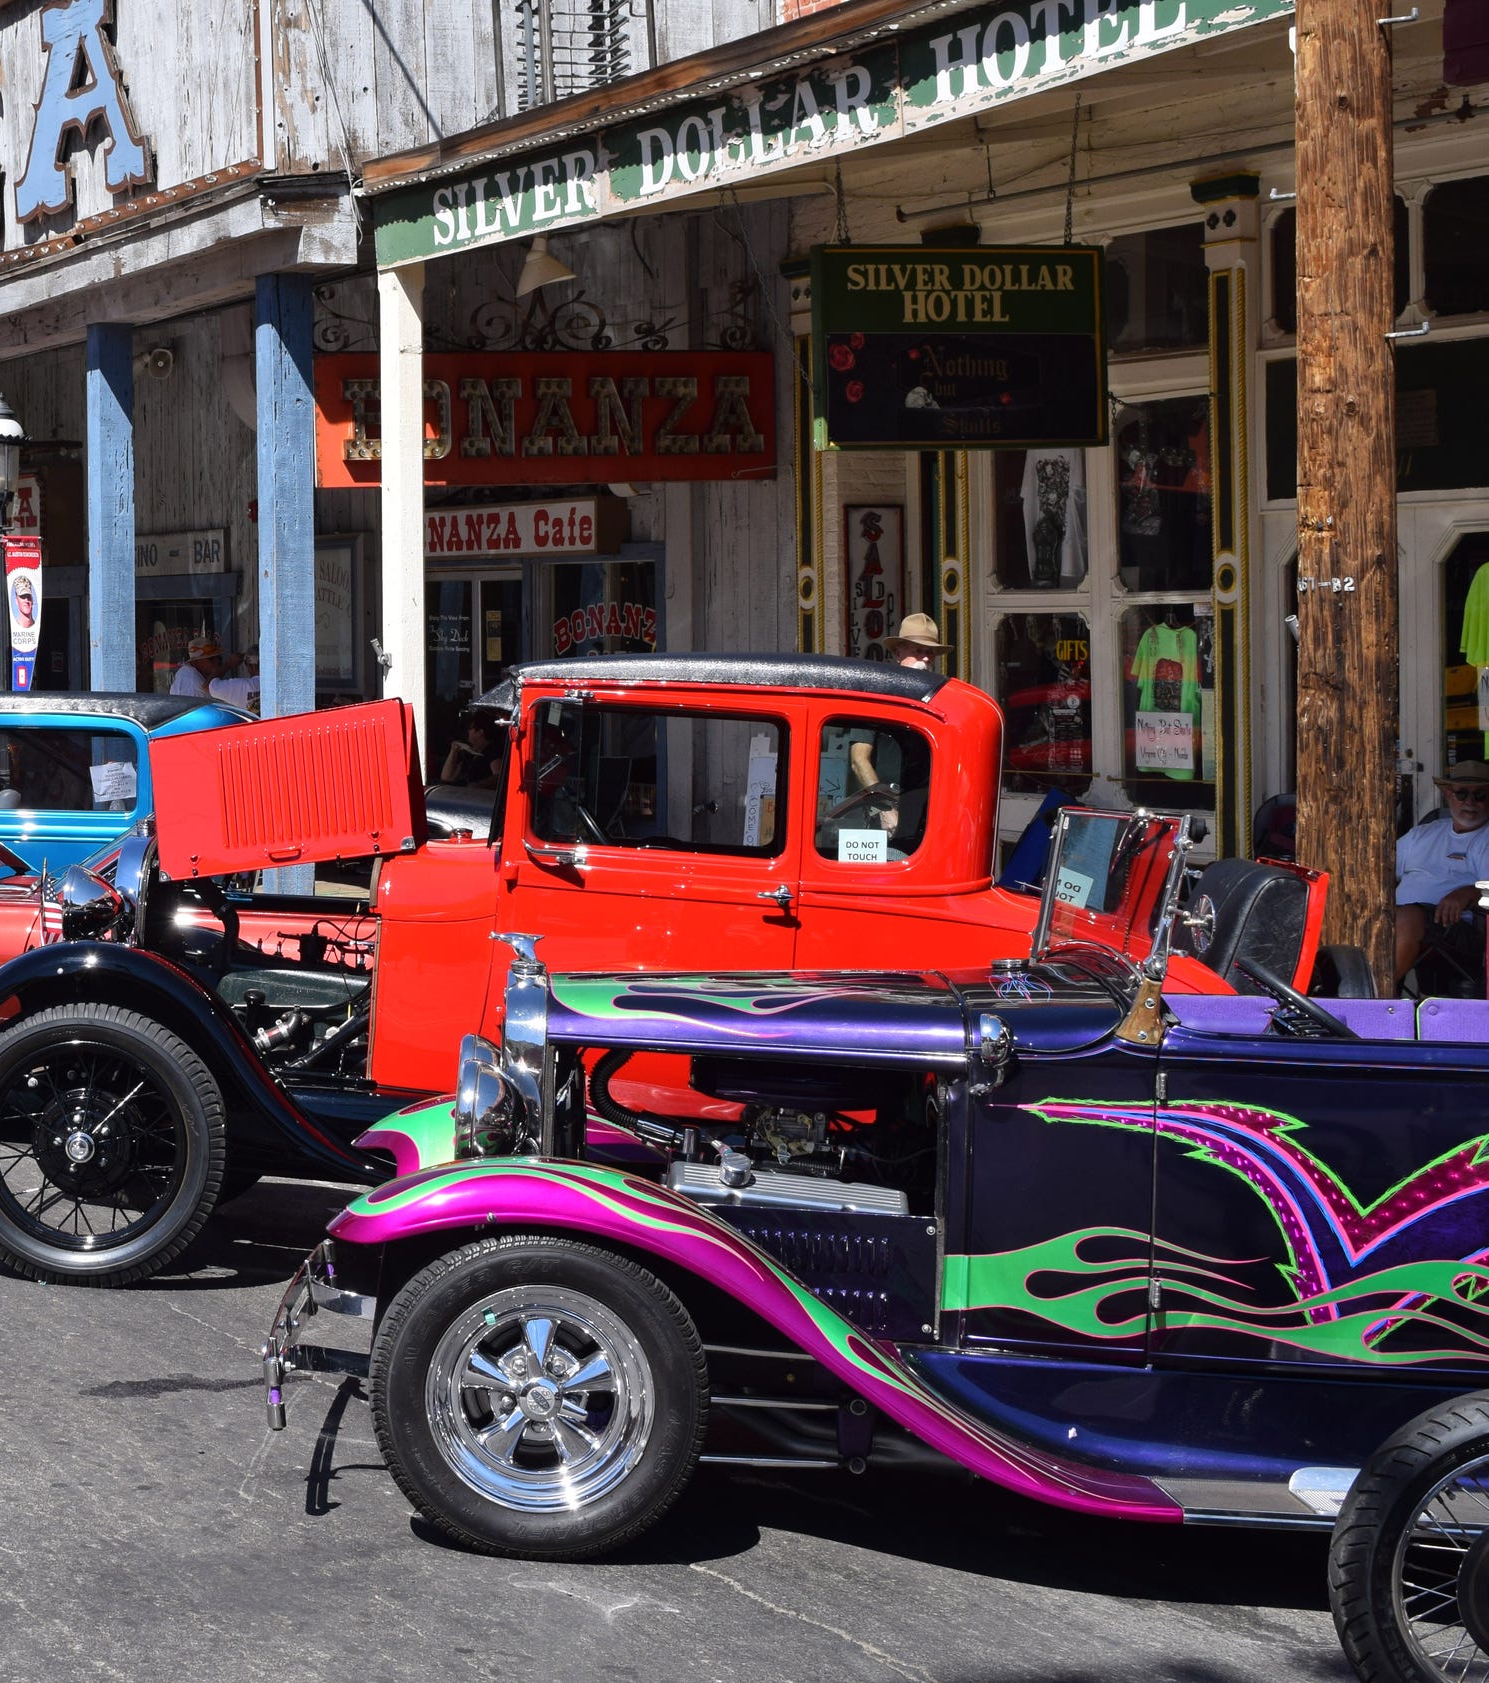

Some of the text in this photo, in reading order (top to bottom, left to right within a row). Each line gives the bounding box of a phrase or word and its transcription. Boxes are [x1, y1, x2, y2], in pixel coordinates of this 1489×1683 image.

[432, 0, 1187, 246] SILVER DOLLAR HOTEL
[846, 263, 1075, 291] SILVER DOLLAR
[902, 290, 1009, 323] HOTEL
[921, 345, 1009, 381] Nothing
[941, 414, 1001, 435] Skulls
[194, 539, 221, 565] BAR
[1055, 639, 1089, 661] GIFTS
[846, 841, 879, 849] DO NOT
[847, 853, 877, 861] TOUCH
